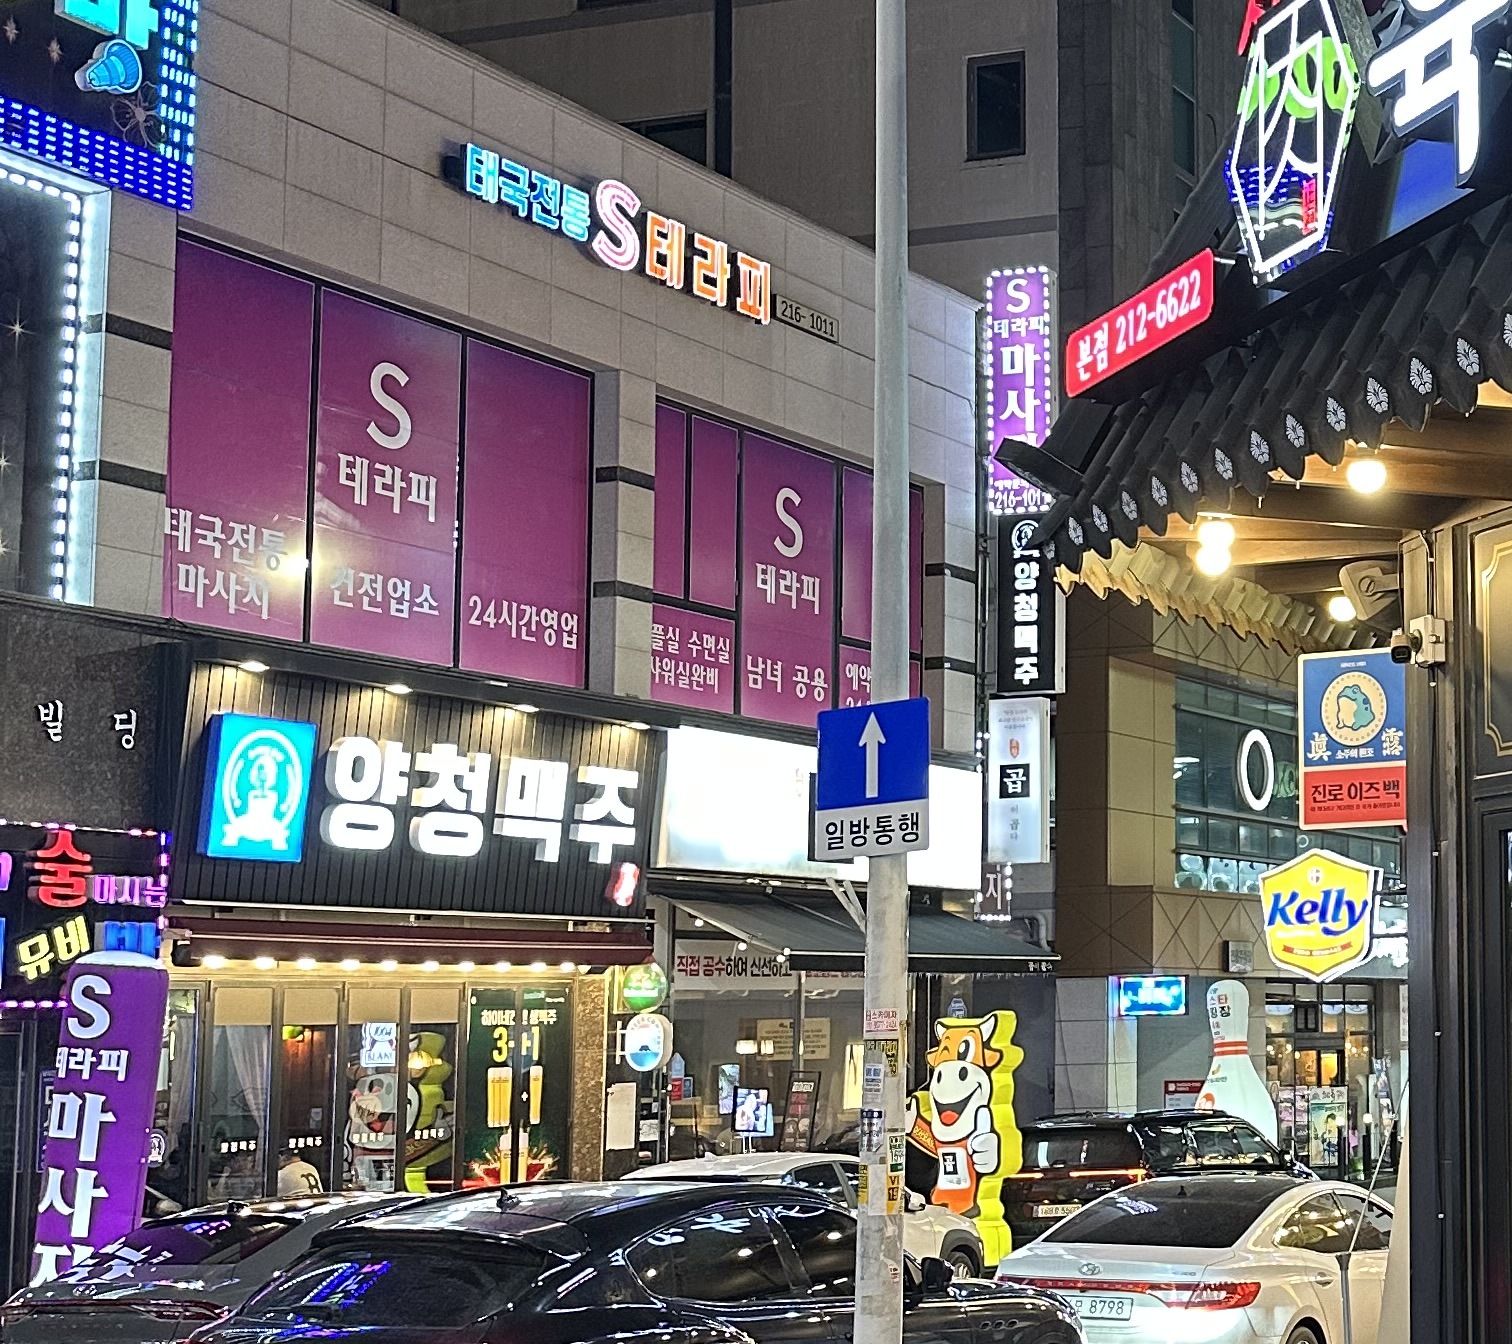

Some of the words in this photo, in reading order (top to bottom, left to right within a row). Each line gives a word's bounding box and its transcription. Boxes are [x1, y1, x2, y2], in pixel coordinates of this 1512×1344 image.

[466, 141, 590, 243] 태국전통
[592, 178, 641, 272] S
[645, 210, 772, 325] 테라피
[779, 298, 836, 339] 216-1011
[1006, 278, 1031, 314] S
[993, 315, 1045, 338] 테라피
[1075, 335, 1109, 382] 본점
[1114, 268, 1203, 355] 212-6622
[366, 361, 414, 450] S
[336, 453, 439, 524] 테라피
[164, 508, 288, 573] 태국전통
[774, 487, 804, 559] S
[178, 564, 271, 620] 마사지
[330, 564, 441, 618] 건전업소
[756, 562, 821, 615] 테라피
[467, 595, 580, 651] 24시간영업
[687, 630, 730, 665] 수면실
[1014, 561, 1040, 686] 양청맥주
[746, 654, 783, 694] 남녀
[792, 664, 829, 702] 공용
[324, 736, 640, 864] 양청맥주
[1003, 767, 1027, 794] 곱
[1311, 783, 1345, 804] 진로
[1347, 781, 1381, 801] 이즈
[1383, 780, 1400, 800] 백
[825, 811, 922, 852] 일방통행
[34, 830, 92, 908] 술
[93, 874, 167, 908] 마시는
[1266, 887, 1369, 937] Kelly
[18, 914, 91, 981] 뮤비
[676, 955, 700, 977] 직접
[702, 955, 748, 978] 공수하여
[67, 974, 112, 1040] S
[1088, 1299, 1124, 1315] 8798
